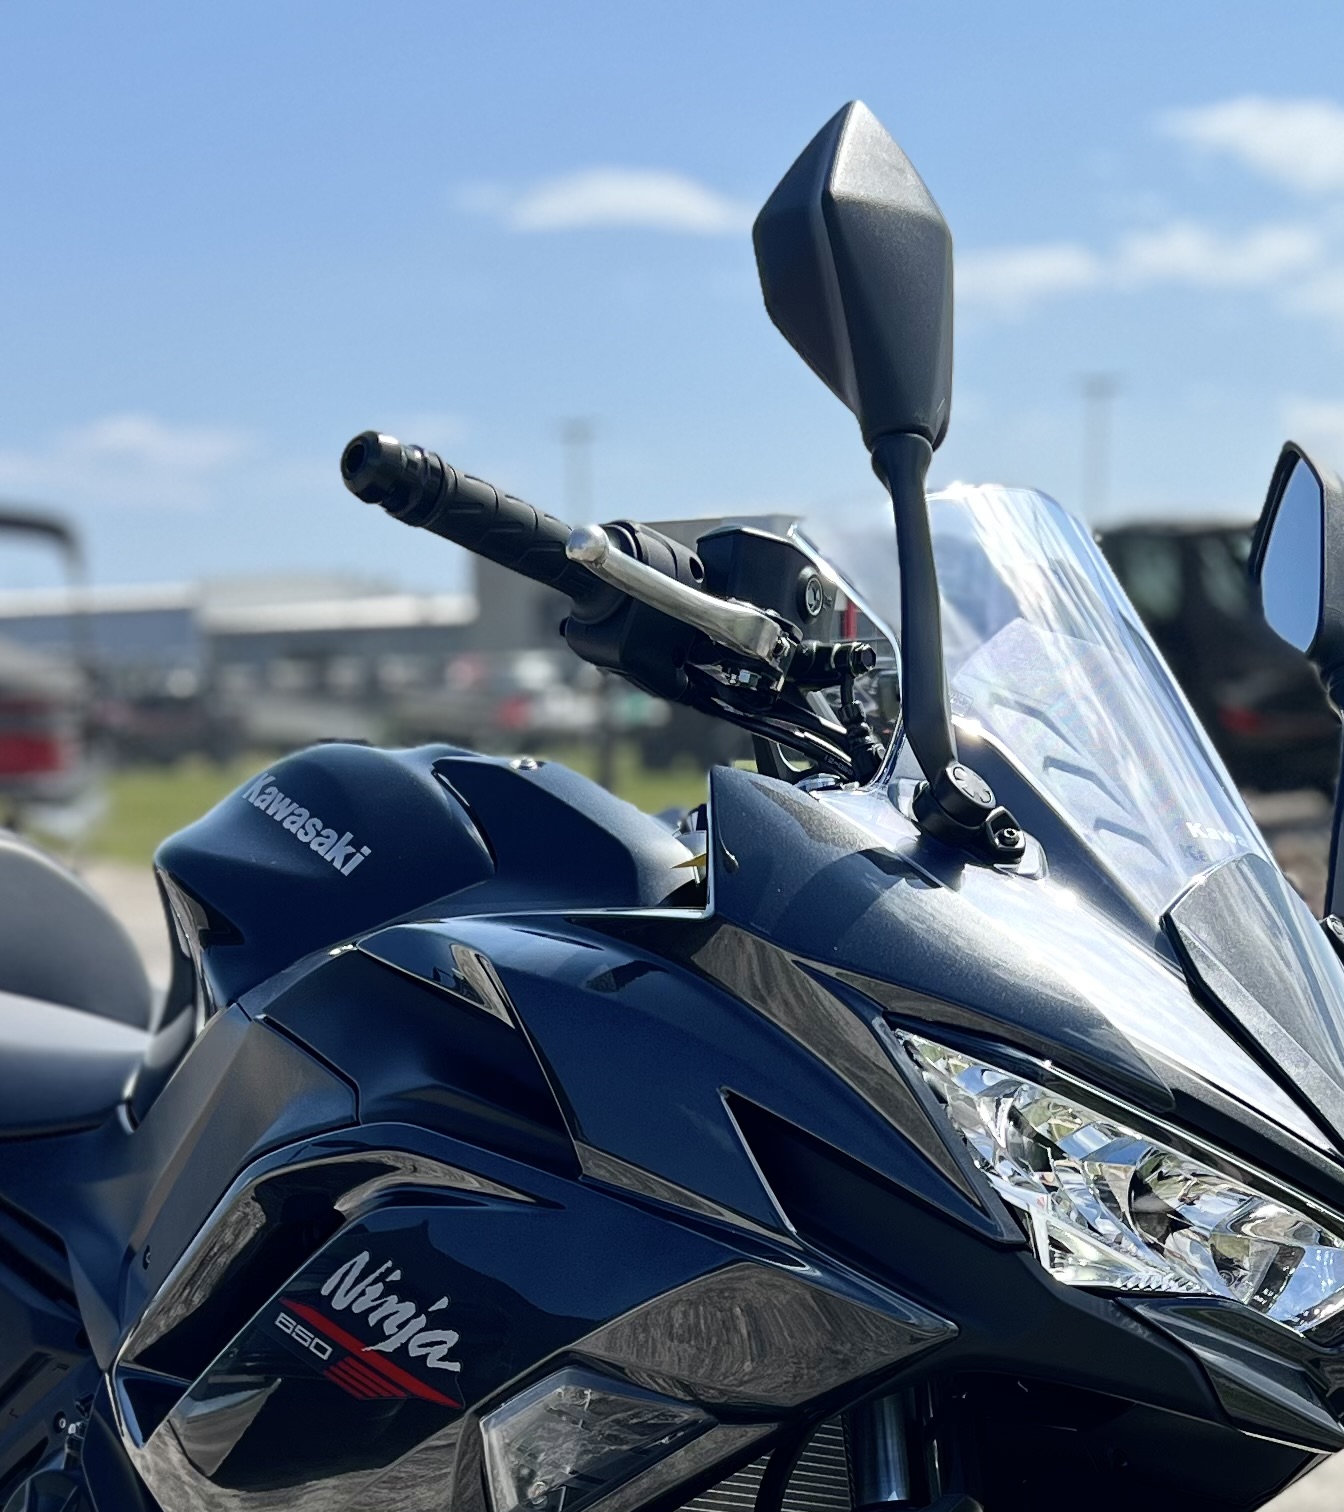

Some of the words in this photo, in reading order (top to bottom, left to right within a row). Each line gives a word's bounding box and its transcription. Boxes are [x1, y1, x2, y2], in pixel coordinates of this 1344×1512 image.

[242, 772, 372, 877] Kawasaki
[274, 1312, 334, 1360] 650
[320, 1250, 461, 1372] Ninja
